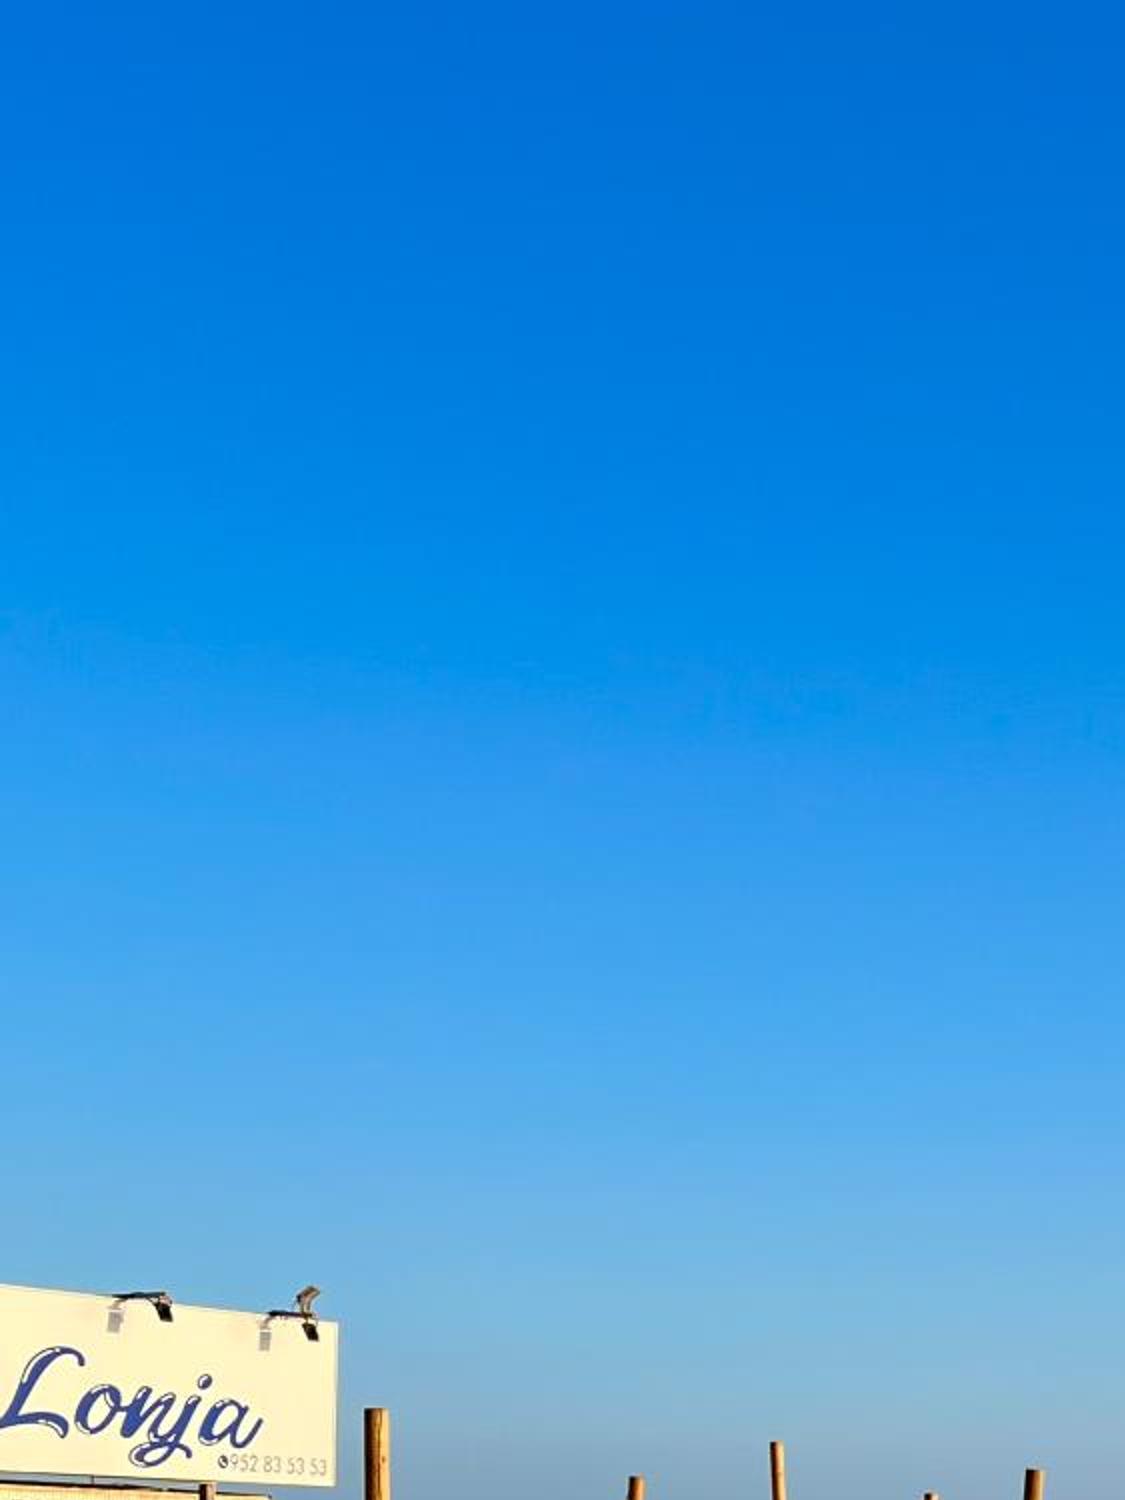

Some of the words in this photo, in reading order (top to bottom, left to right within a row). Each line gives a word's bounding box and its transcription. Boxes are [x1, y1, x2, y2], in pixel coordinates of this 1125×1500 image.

[0, 1345, 264, 1468] Lonja
[230, 1453, 259, 1472] 952
[263, 1455, 282, 1473] 83
[287, 1457, 305, 1476] 53
[309, 1458, 327, 1476] 53
